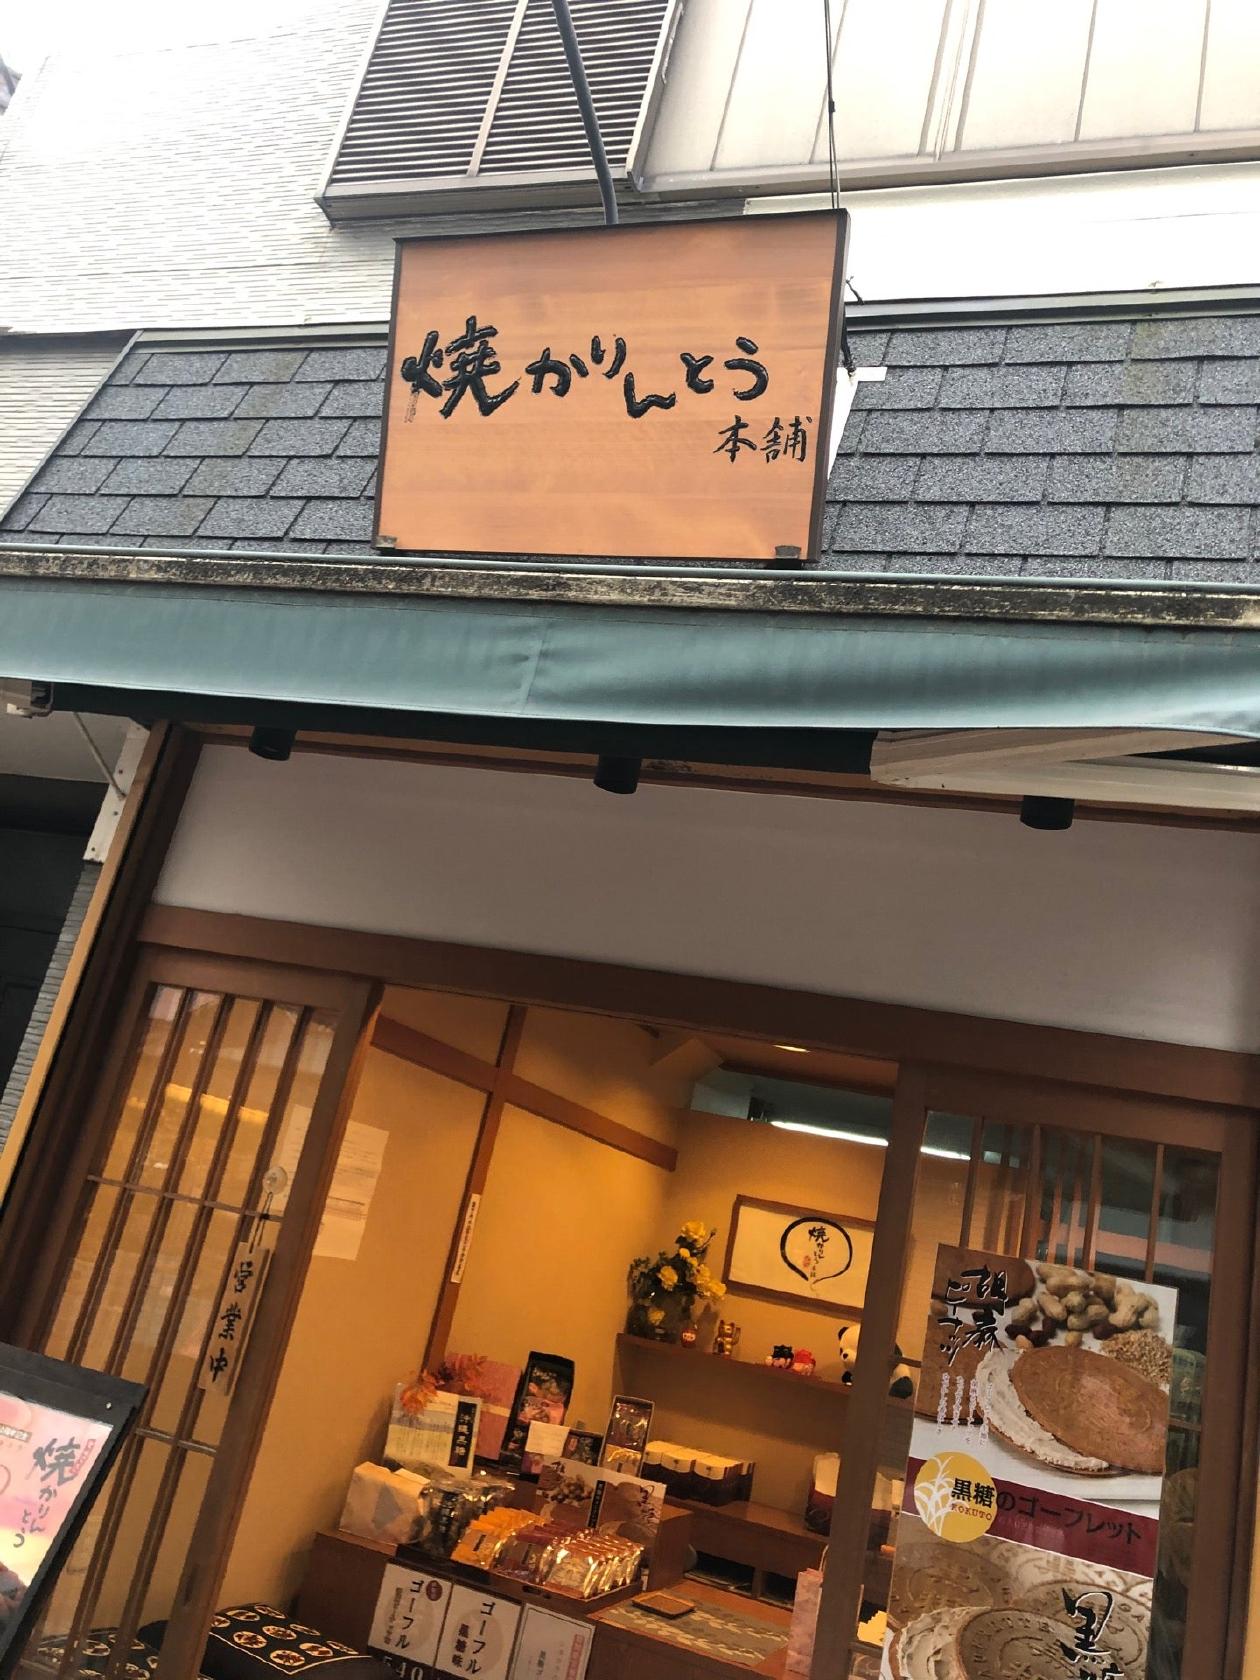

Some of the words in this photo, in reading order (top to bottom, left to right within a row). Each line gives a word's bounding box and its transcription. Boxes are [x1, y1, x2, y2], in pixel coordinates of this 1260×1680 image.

[401, 315, 769, 418] 焼かりんとう
[713, 415, 813, 463] 本舗
[210, 1260, 253, 1383] 営業中
[395, 1579, 425, 1650] ゴーフル
[464, 1601, 497, 1675] ゴーフル
